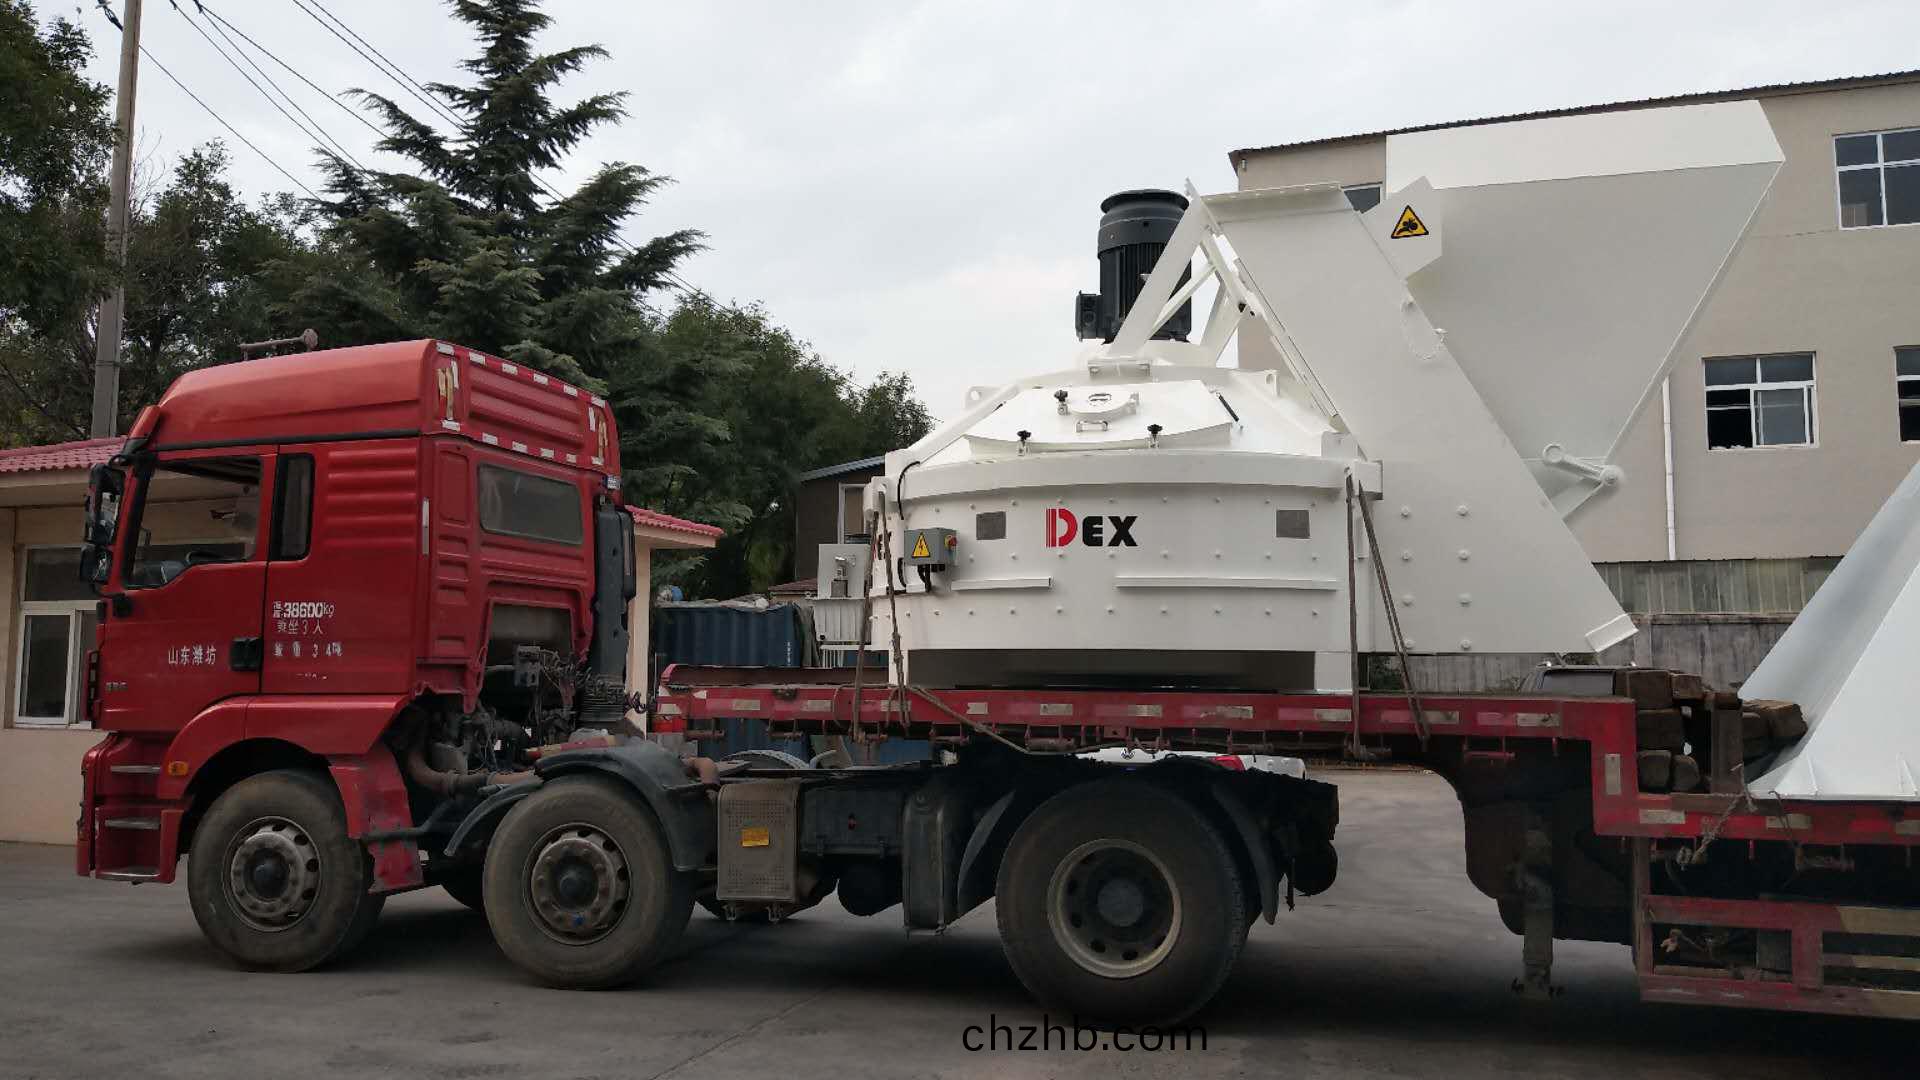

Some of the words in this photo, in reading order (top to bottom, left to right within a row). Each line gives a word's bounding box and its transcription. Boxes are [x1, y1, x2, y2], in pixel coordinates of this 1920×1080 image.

[1046, 508, 1138, 548] DEX
[168, 645, 217, 666] 山东潍坊
